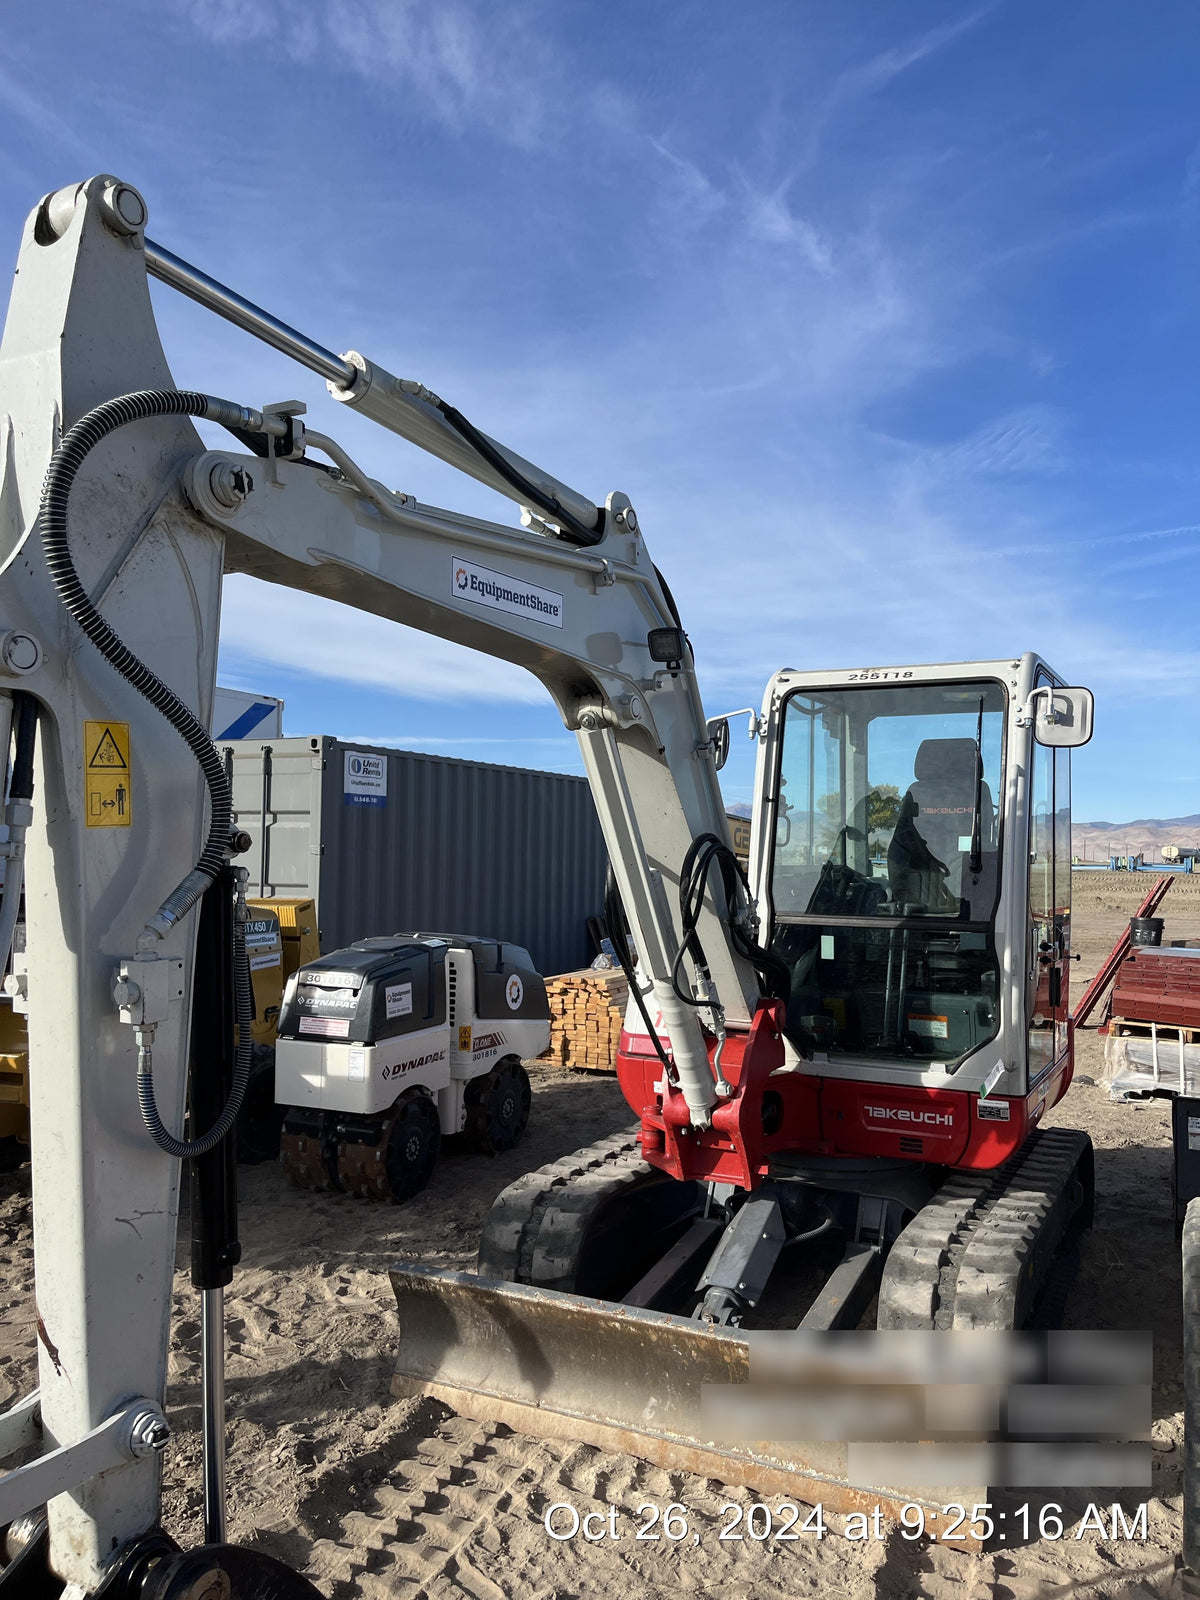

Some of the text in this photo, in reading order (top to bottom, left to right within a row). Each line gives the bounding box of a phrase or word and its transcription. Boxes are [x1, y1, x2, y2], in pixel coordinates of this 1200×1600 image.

[470, 574, 559, 616] EquipmentShare
[848, 671, 914, 681] 255118
[245, 921, 267, 933] TX450
[307, 974, 353, 985] 301816
[305, 998, 358, 1009] DYNAPAC
[472, 1048, 498, 1061] 301816
[391, 1050, 446, 1076] DYNAPAC
[864, 1106, 953, 1126] TAKEUCHI
